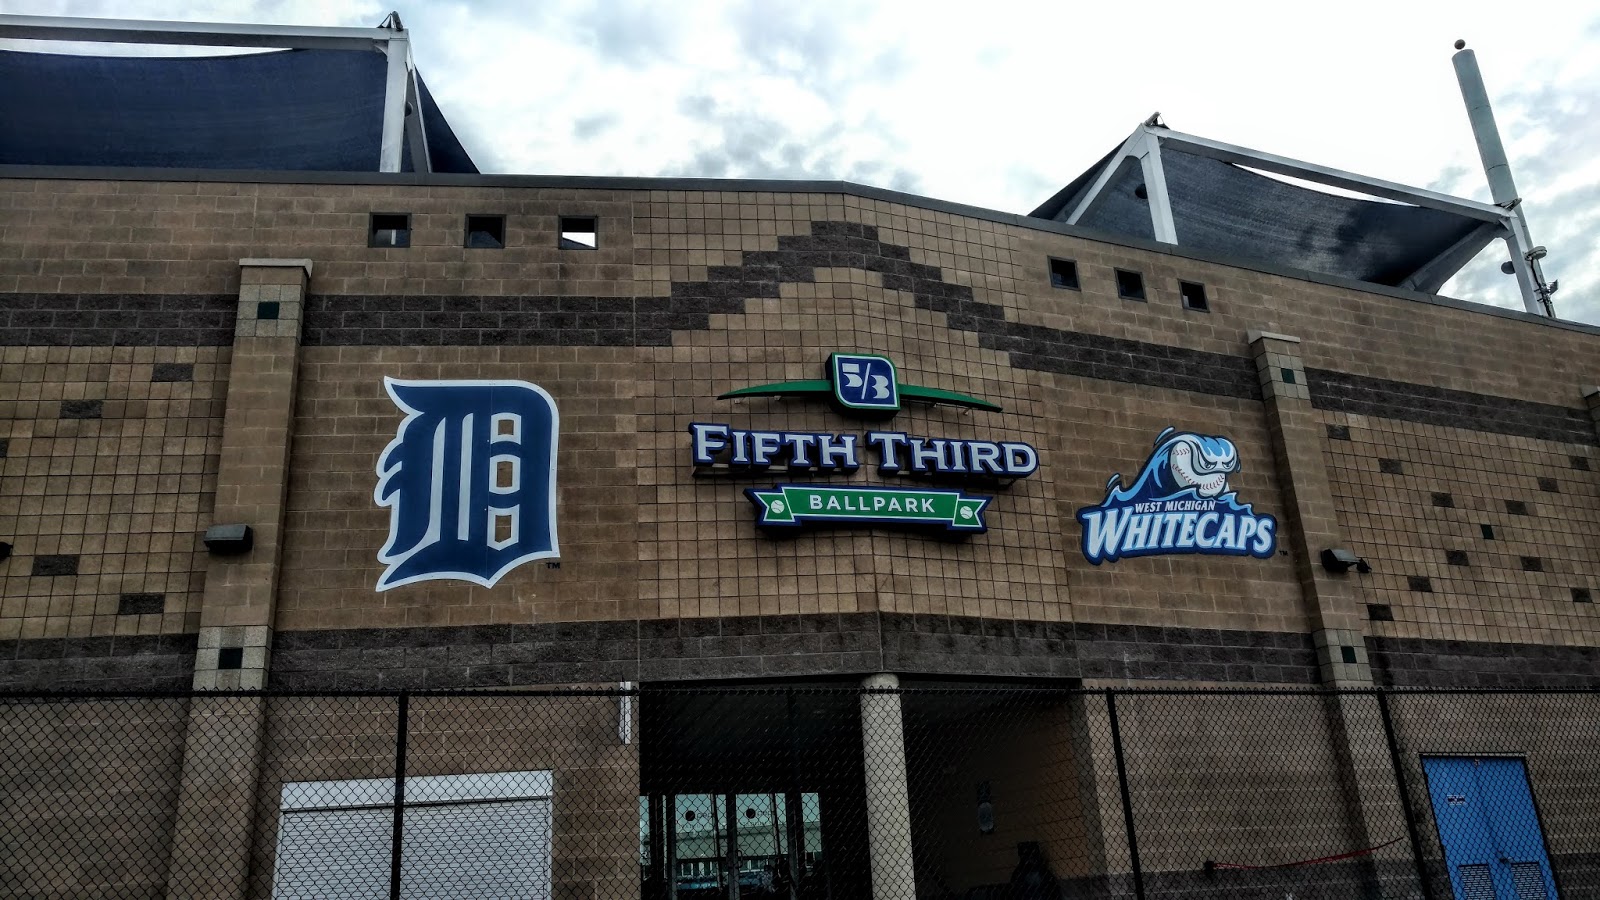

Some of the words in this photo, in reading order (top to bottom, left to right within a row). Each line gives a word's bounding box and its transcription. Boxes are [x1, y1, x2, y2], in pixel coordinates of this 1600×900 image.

[690, 422, 860, 469] FIFTH
[868, 431, 1039, 475] THIRD
[809, 494, 936, 514] BALLPARK
[1134, 501, 1163, 514] WEST
[1164, 500, 1217, 512] MICHIGAN
[1080, 505, 1274, 558] WHITECAPS
